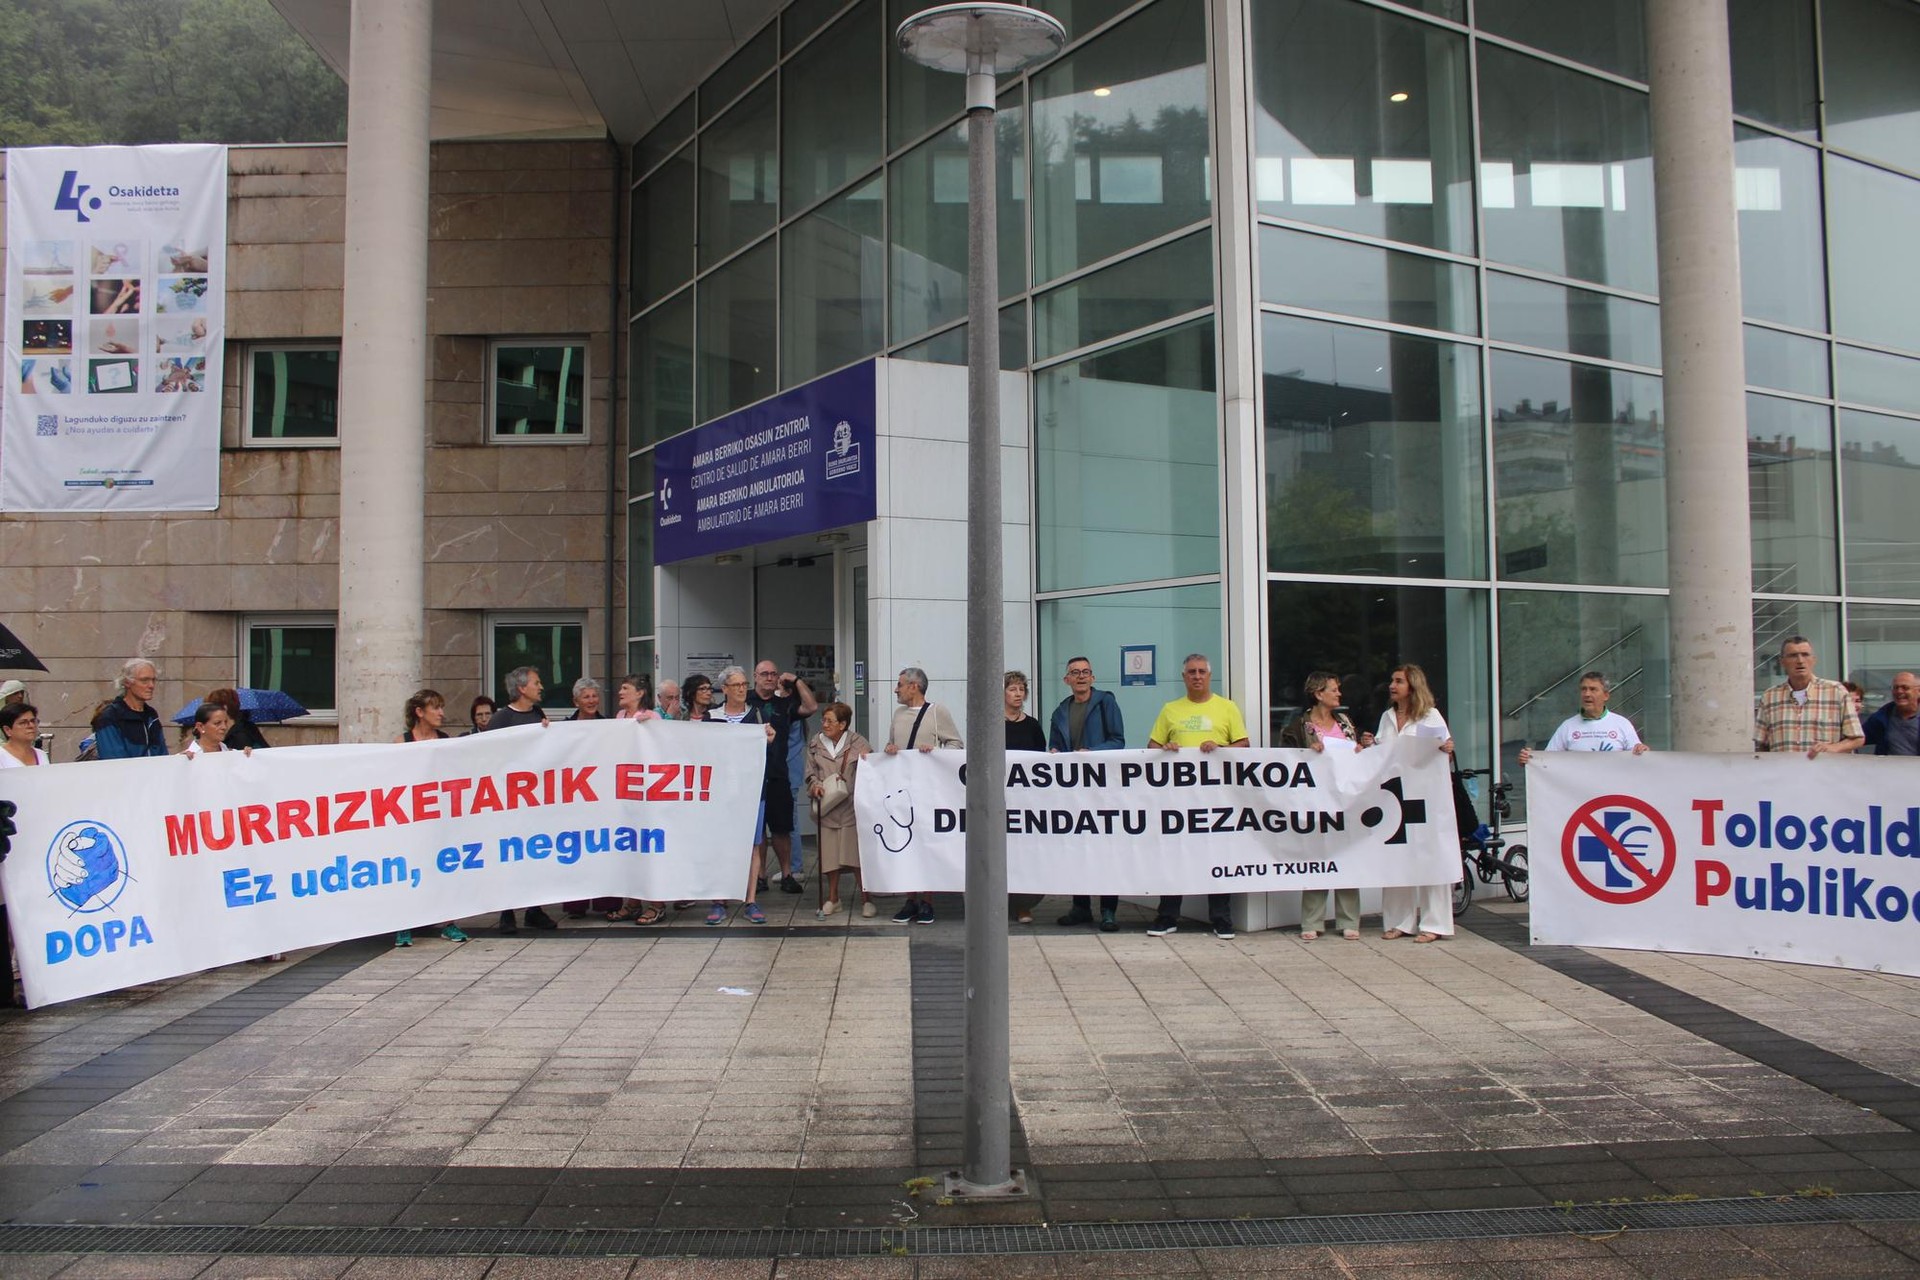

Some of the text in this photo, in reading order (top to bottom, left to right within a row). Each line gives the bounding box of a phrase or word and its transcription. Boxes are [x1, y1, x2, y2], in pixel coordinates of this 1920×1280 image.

[108, 185, 179, 197] Osakidetza
[64, 415, 108, 425] Lagunduko
[110, 415, 137, 425] diguzu
[150, 415, 186, 423] zaintzen?
[87, 426, 115, 434] ayudas
[691, 438, 811, 490] CENTRO DE SALUD DE AMARA BERRI
[692, 416, 810, 469] AMARA BERRIKO OSASUN ZENTROA
[697, 469, 805, 513] AMARA BERRIKO ANBULATORIOA
[697, 492, 804, 532] AMBULATORIO DE AMARA BERRI
[958, 761, 1316, 788] ASUN PUBLIKOA
[165, 763, 712, 857] MURRIZKETARIK EZ!!
[1161, 807, 1345, 834] DEZAGUN
[1692, 799, 1920, 859] Tolosald
[223, 826, 665, 908] Ez udan, ez neguan
[1211, 861, 1338, 878] OLATU TXURIA
[1695, 859, 1920, 924] Publiko
[46, 915, 154, 965] DOPA
